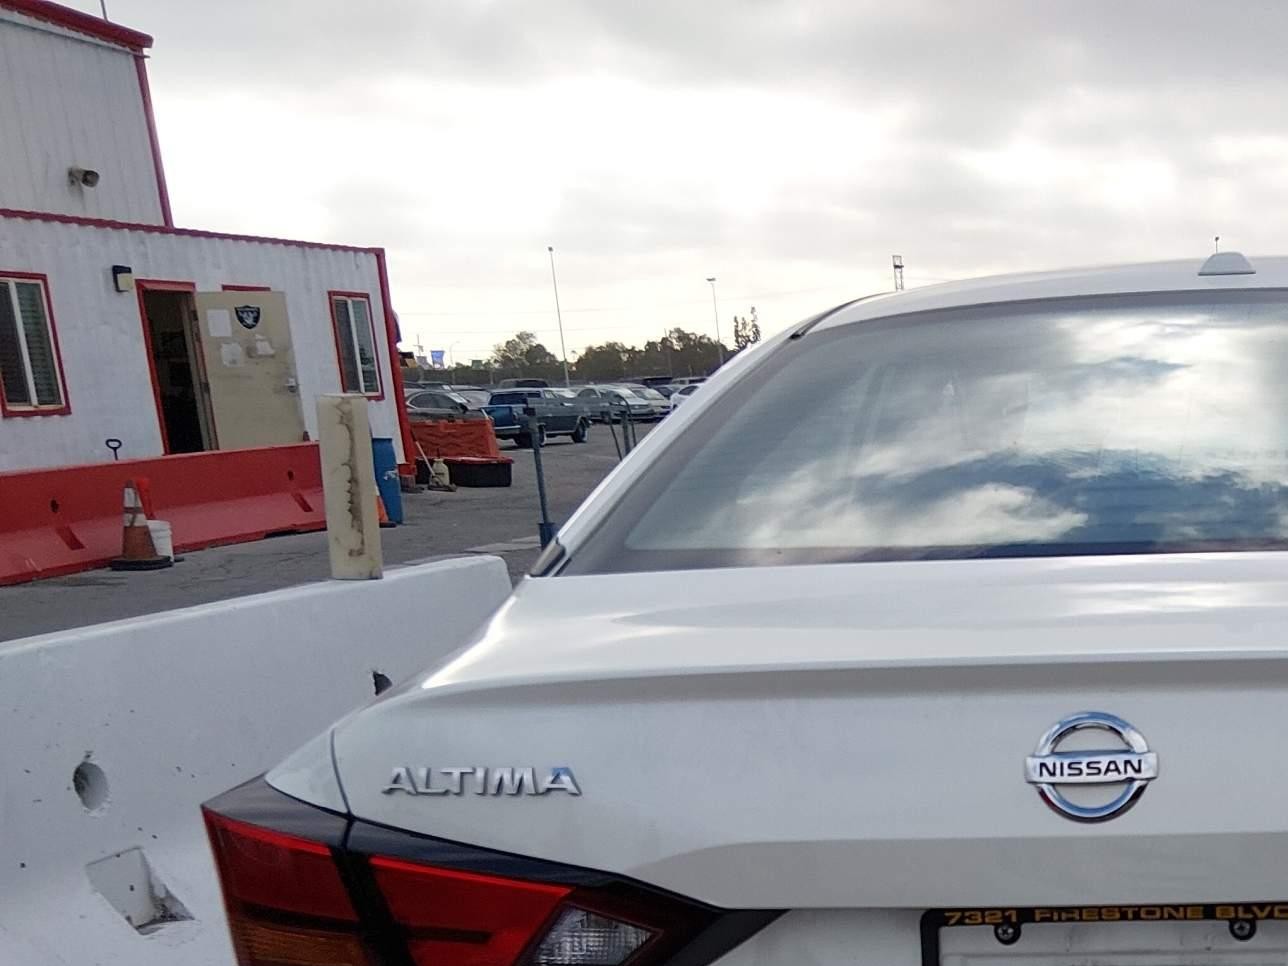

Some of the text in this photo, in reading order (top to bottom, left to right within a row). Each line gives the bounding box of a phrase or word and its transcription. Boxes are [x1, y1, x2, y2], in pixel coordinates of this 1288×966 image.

[1039, 759, 1143, 778] NISSAN
[382, 767, 582, 796] ALTIMA
[944, 910, 1017, 925] 7321
[1034, 906, 1204, 922] FIRESTONE
